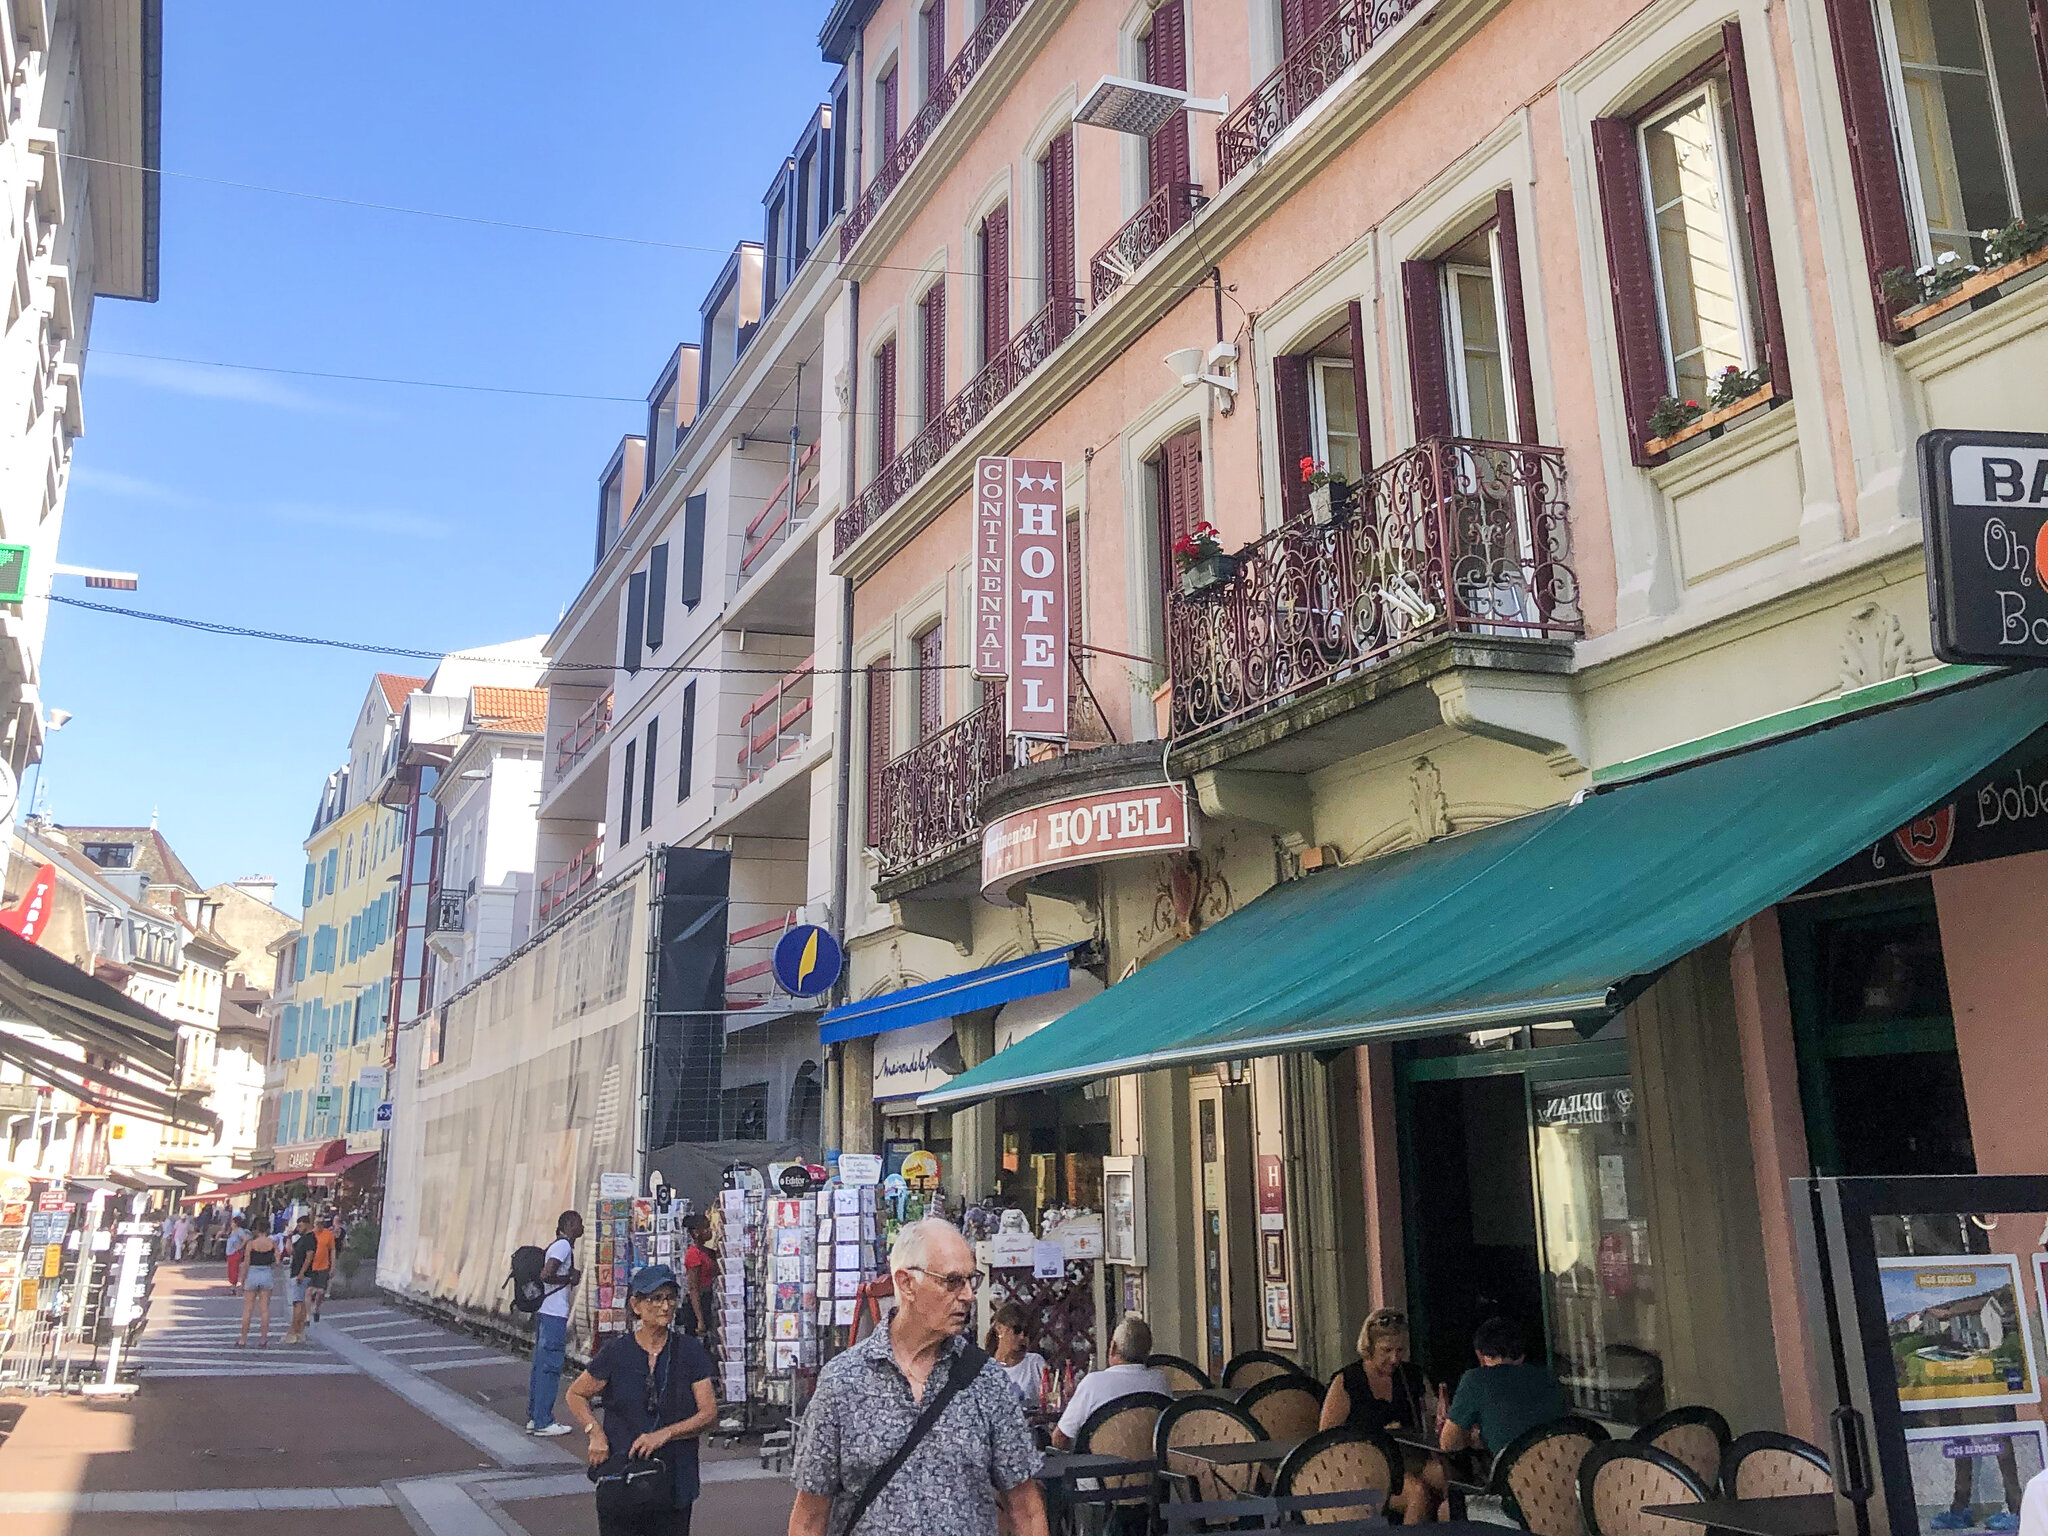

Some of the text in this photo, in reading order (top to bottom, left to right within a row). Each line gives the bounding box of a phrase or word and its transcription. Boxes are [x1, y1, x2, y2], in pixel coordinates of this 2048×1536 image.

[981, 465, 1003, 669] CONTINENTAL
[1984, 517, 2031, 586] Oh
[1018, 502, 1057, 713] HOTEL
[1047, 797, 1173, 850] HOTEL
[320, 1043, 333, 1095] HOTEL
[1267, 1165, 1280, 1187] H
